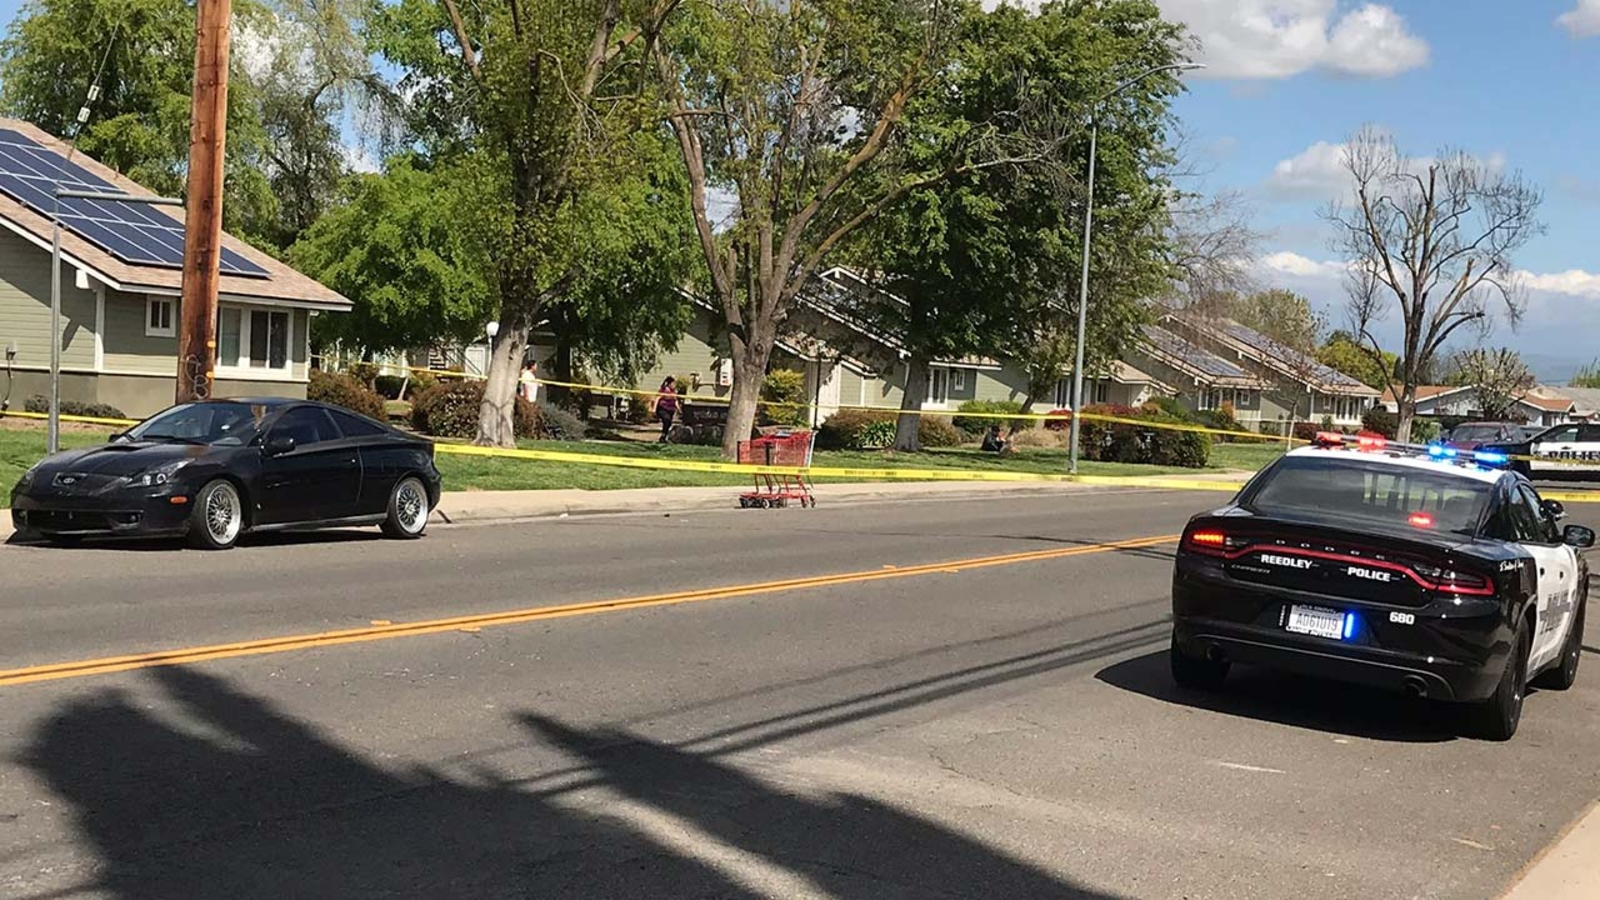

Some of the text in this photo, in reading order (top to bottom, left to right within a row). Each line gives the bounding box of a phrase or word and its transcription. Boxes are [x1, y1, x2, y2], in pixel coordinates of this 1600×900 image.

[1260, 554, 1313, 569] REEDLEY
[1347, 567, 1391, 582] POLICE
[1389, 611, 1415, 625] 680
